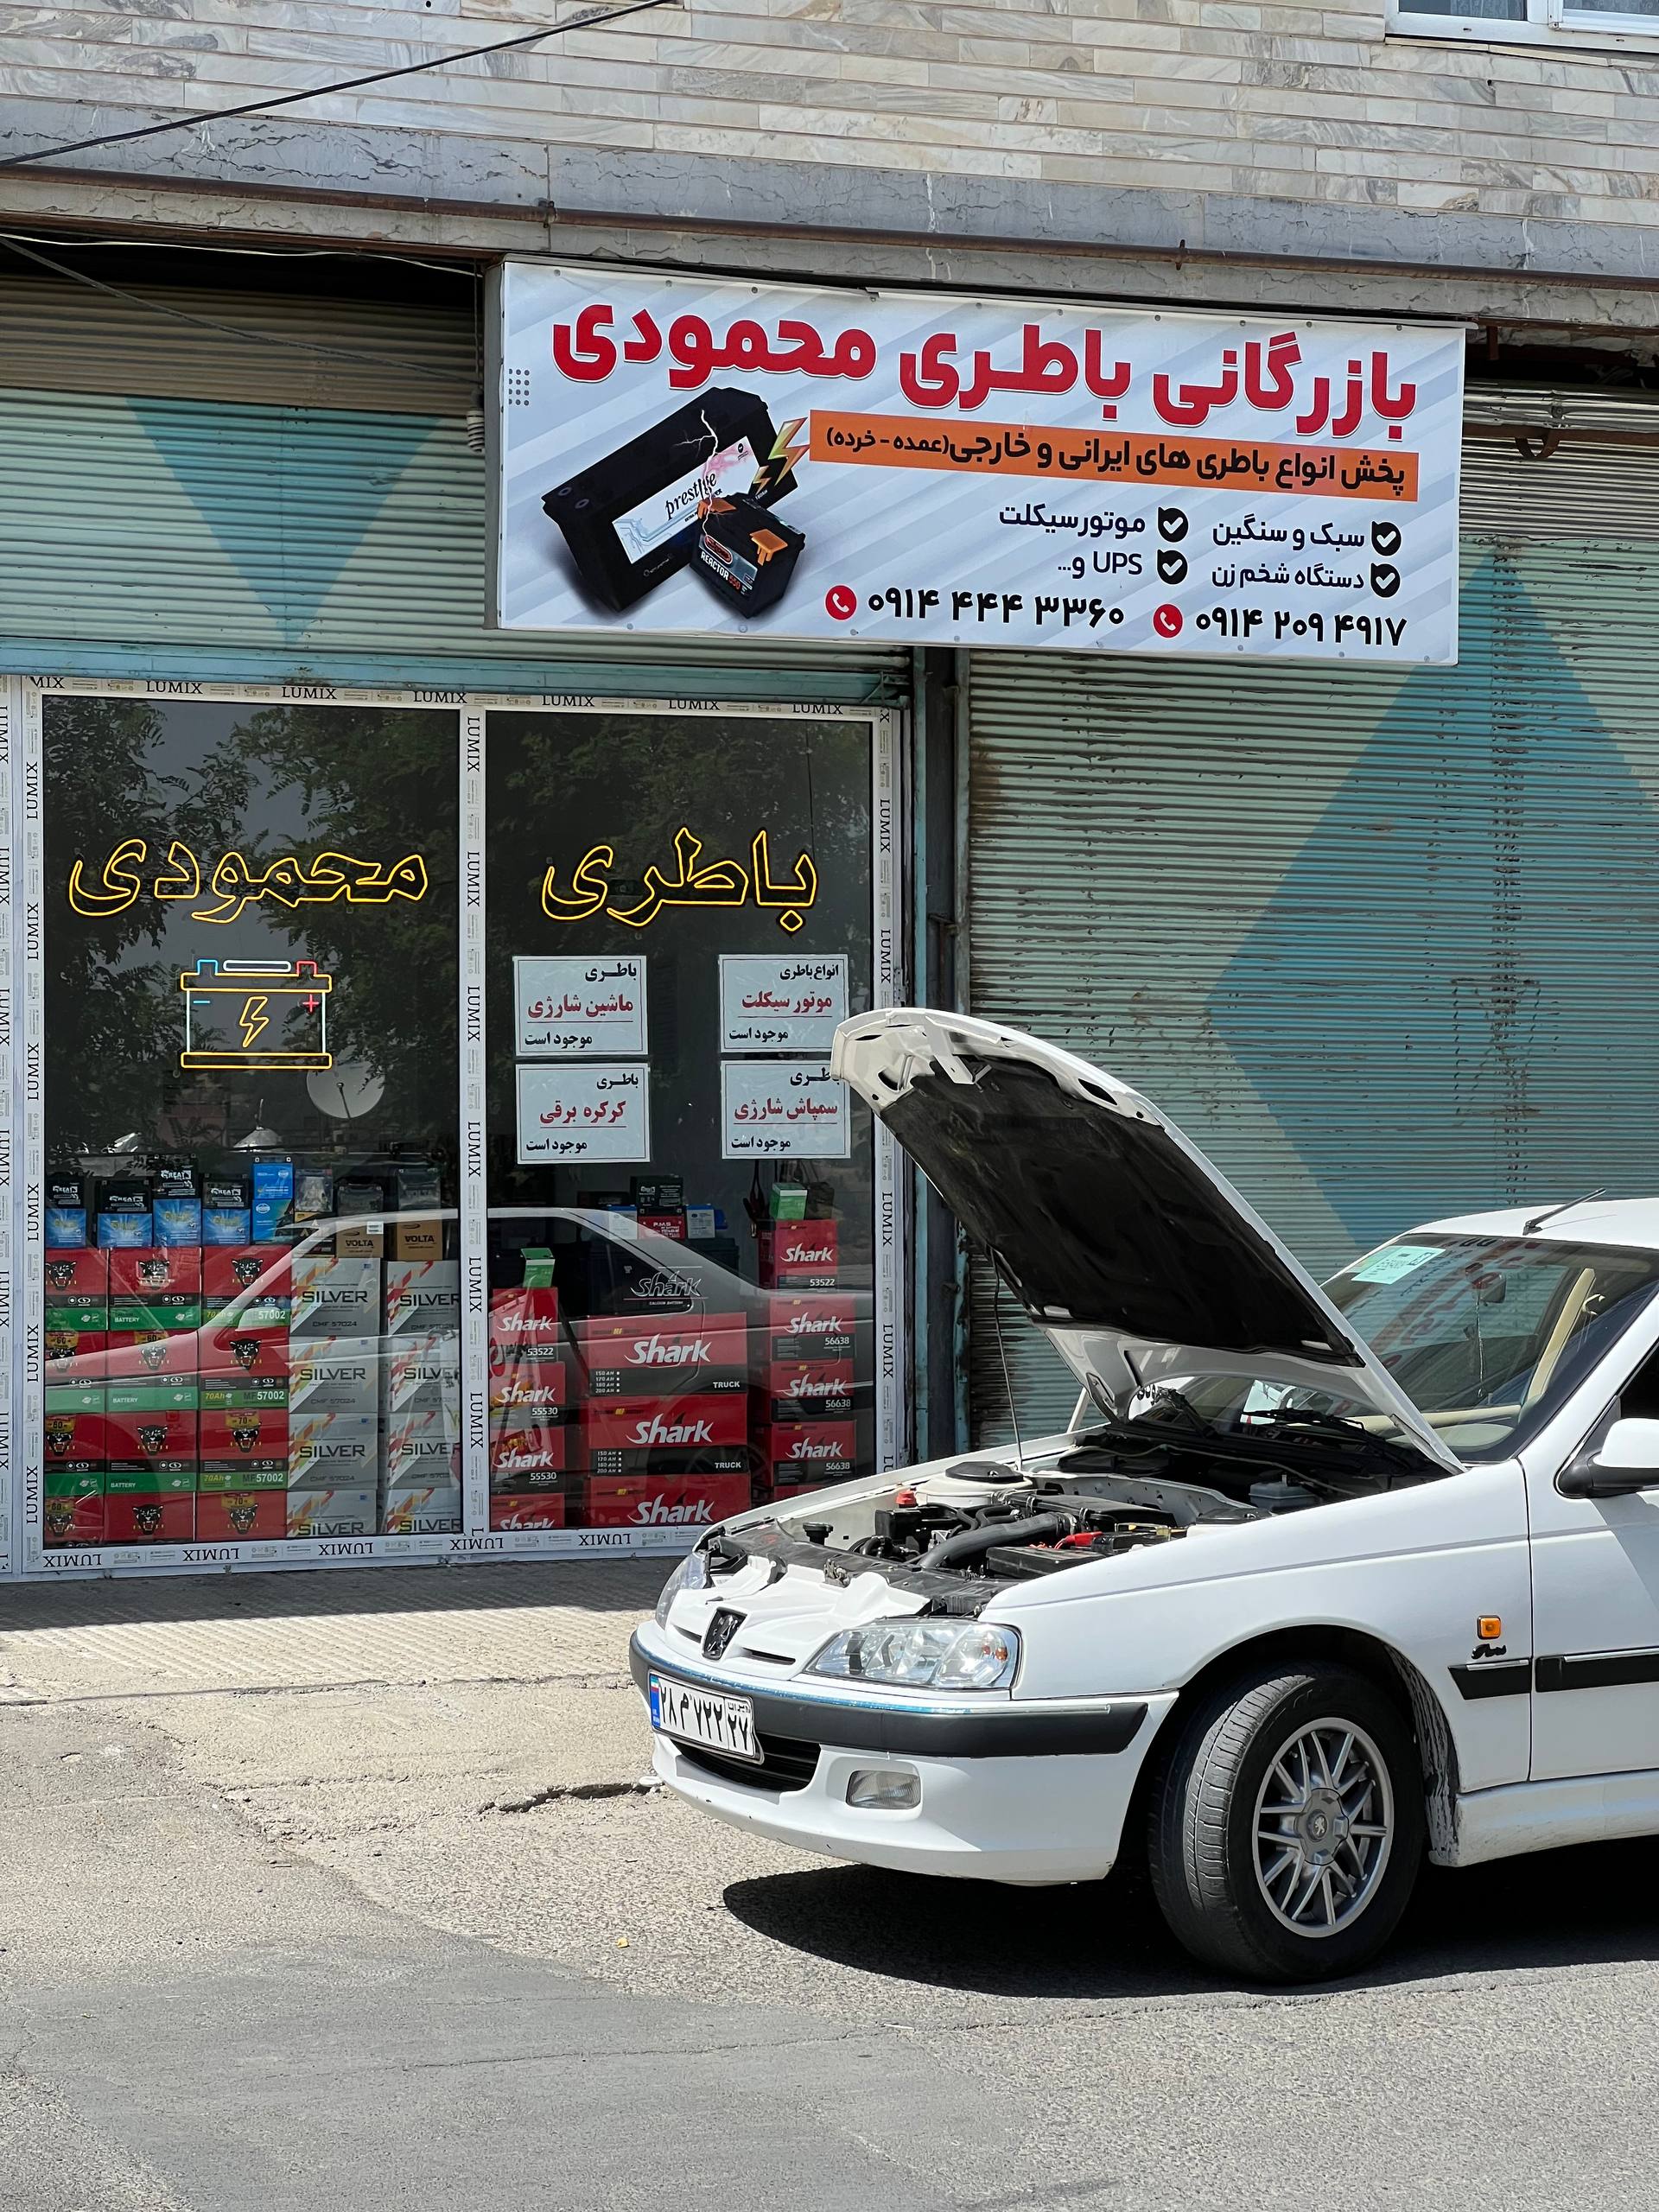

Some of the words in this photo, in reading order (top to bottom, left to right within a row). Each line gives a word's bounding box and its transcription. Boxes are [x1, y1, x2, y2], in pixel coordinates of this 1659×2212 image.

[552, 304, 877, 390] محمودی
[899, 323, 1132, 422] باطری
[1153, 330, 1417, 442] بازرگانی
[1037, 442, 1052, 467] و
[1058, 437, 1130, 473] ایرانی
[1135, 443, 1191, 474] های
[1196, 450, 1269, 480] باطری
[1274, 454, 1335, 489] انواع
[1340, 457, 1405, 496] پخش
[1212, 513, 1287, 548] سنگین
[1293, 529, 1305, 550] و
[1310, 521, 1365, 549] سبک
[701, 551, 729, 581] REACTOR
[1092, 550, 1143, 575] UPS
[1211, 563, 1237, 588] زن
[1239, 562, 1291, 588] شخم
[1294, 561, 1364, 589] دستگاه
[868, 587, 939, 620] ۰۹۱۴
[951, 590, 1023, 624] ۴۴۴
[1034, 594, 1125, 628] ۳۳۶۰
[1195, 606, 1264, 640] ۰۹۱۴
[1274, 610, 1324, 643] ۲۰۹
[1334, 613, 1408, 646] ۴۹۱۷
[30, 677, 65, 689] MIX
[146, 680, 203, 694] LUMIX
[282, 685, 337, 699] LUMIX
[413, 690, 467, 704] LUMIX
[542, 696, 594, 707] LUMIX
[669, 699, 720, 710] LUMIX
[791, 703, 843, 715] LUMIX
[467, 716, 480, 772] LUMIX
[27, 762, 38, 820] LUMIX
[880, 799, 891, 853] LUMIX
[69, 839, 428, 924] محمودی
[467, 851, 480, 907] LUMIX
[542, 827, 817, 932] باطری
[27, 901, 39, 960] LUMIX
[880, 929, 891, 984] LUMIX
[584, 962, 638, 982] باطری
[779, 963, 814, 981] باطری
[815, 964, 839, 980] انواع
[527, 994, 582, 1019] شارژی
[585, 993, 634, 1018] ماشین
[741, 990, 790, 1012] سیکلت
[792, 994, 832, 1014] موتور
[467, 986, 480, 1042] LUMIX
[524, 1031, 550, 1046] است
[553, 1033, 593, 1049] موجود
[728, 1027, 752, 1039] است
[755, 1029, 789, 1044] موجود
[28, 1042, 39, 1101] LUMIX
[596, 1071, 639, 1090] باطری
[790, 1066, 840, 1086] طری
[540, 1101, 577, 1125] برقی
[583, 1100, 626, 1123] کرکره
[734, 1097, 783, 1121] شارژی
[786, 1099, 838, 1122] سمپاش
[468, 1122, 481, 1177] LUMIX
[525, 1137, 550, 1152] است
[551, 1139, 588, 1154] موجود
[731, 1135, 754, 1149] است
[756, 1136, 791, 1151] موجود
[28, 1183, 39, 1242] LUMIX
[882, 1192, 893, 1246] LUMIX
[780, 1243, 834, 1262] Shark
[469, 1256, 482, 1313] LUMIX
[631, 1270, 702, 1297] Shark
[302, 1290, 368, 1303] SILVER
[258, 1310, 286, 1319] 57002
[497, 1312, 554, 1332] Shark
[785, 1312, 844, 1334] Shark
[27, 1324, 39, 1383] LUMIX
[527, 1347, 554, 1356] 53522
[624, 1333, 712, 1364] Shark
[883, 1324, 893, 1379] LUMIX
[300, 1368, 366, 1380] SILVER
[783, 1372, 847, 1397] Shark
[257, 1390, 285, 1400] 57002
[495, 1381, 556, 1403] Shark
[825, 1399, 851, 1408] 56638
[470, 1392, 484, 1448] LUMIX
[531, 1407, 558, 1416] 55530
[626, 1413, 714, 1444] Shark
[299, 1445, 366, 1458] SILVER
[493, 1446, 555, 1469] Shark
[785, 1437, 843, 1459] Shark
[256, 1472, 283, 1483] 57002
[530, 1471, 557, 1481] 55530
[825, 1462, 850, 1471] 56638
[26, 1465, 39, 1523] LUMIX
[627, 1493, 715, 1525] Shark
[298, 1522, 365, 1535] SILVER
[579, 1532, 631, 1547] LUMIX
[182, 1548, 239, 1561] LUMIX
[318, 1541, 373, 1555] LUMIX
[449, 1537, 504, 1551] LUMIX
[43, 1554, 102, 1567] LUMIX
